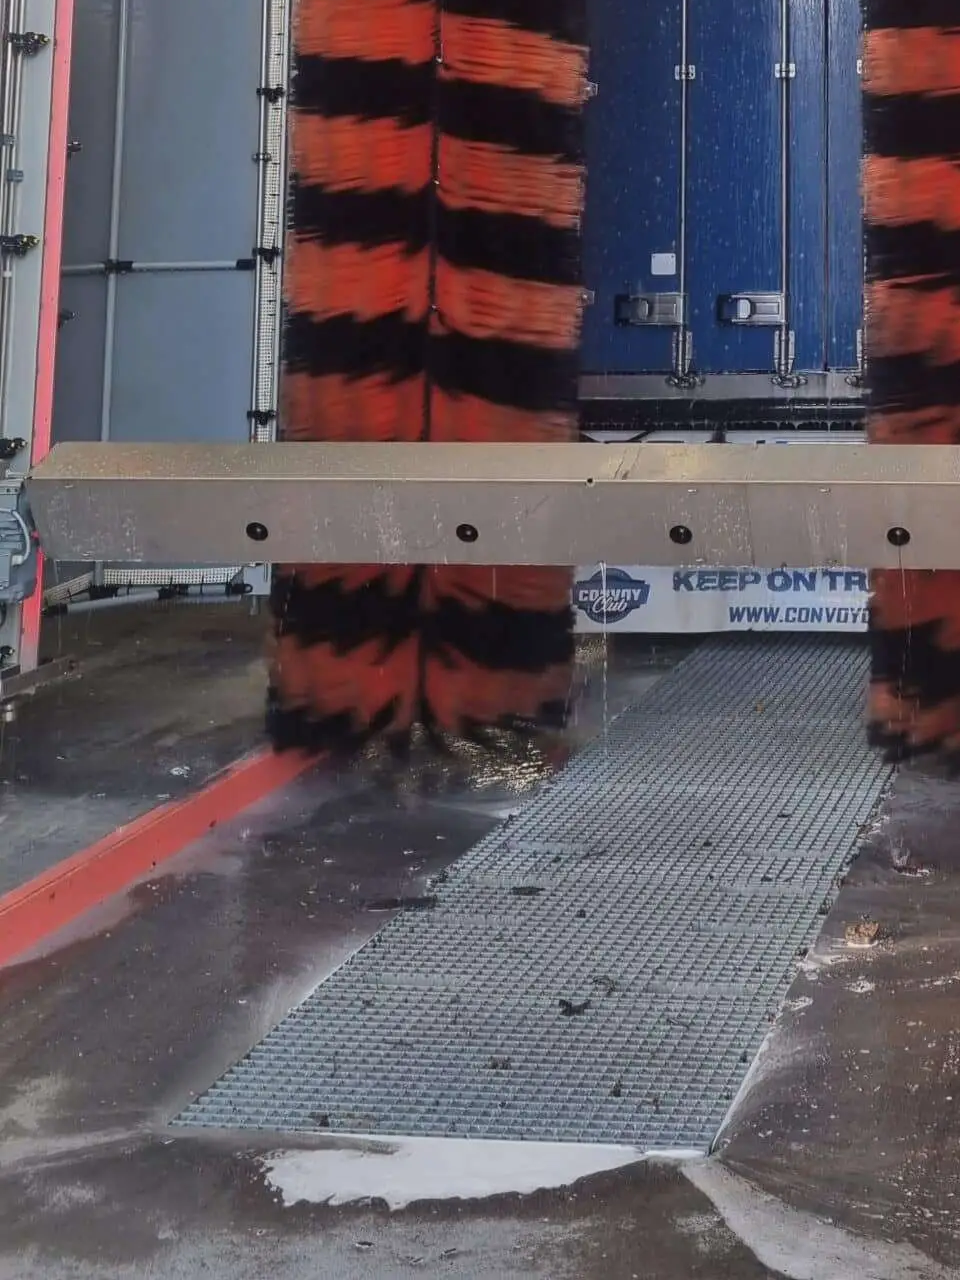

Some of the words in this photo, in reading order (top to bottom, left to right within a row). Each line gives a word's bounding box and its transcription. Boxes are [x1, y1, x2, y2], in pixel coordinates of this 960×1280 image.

[672, 570, 762, 592] KEEP
[766, 570, 817, 593] ON
[591, 595, 628, 614] Club
